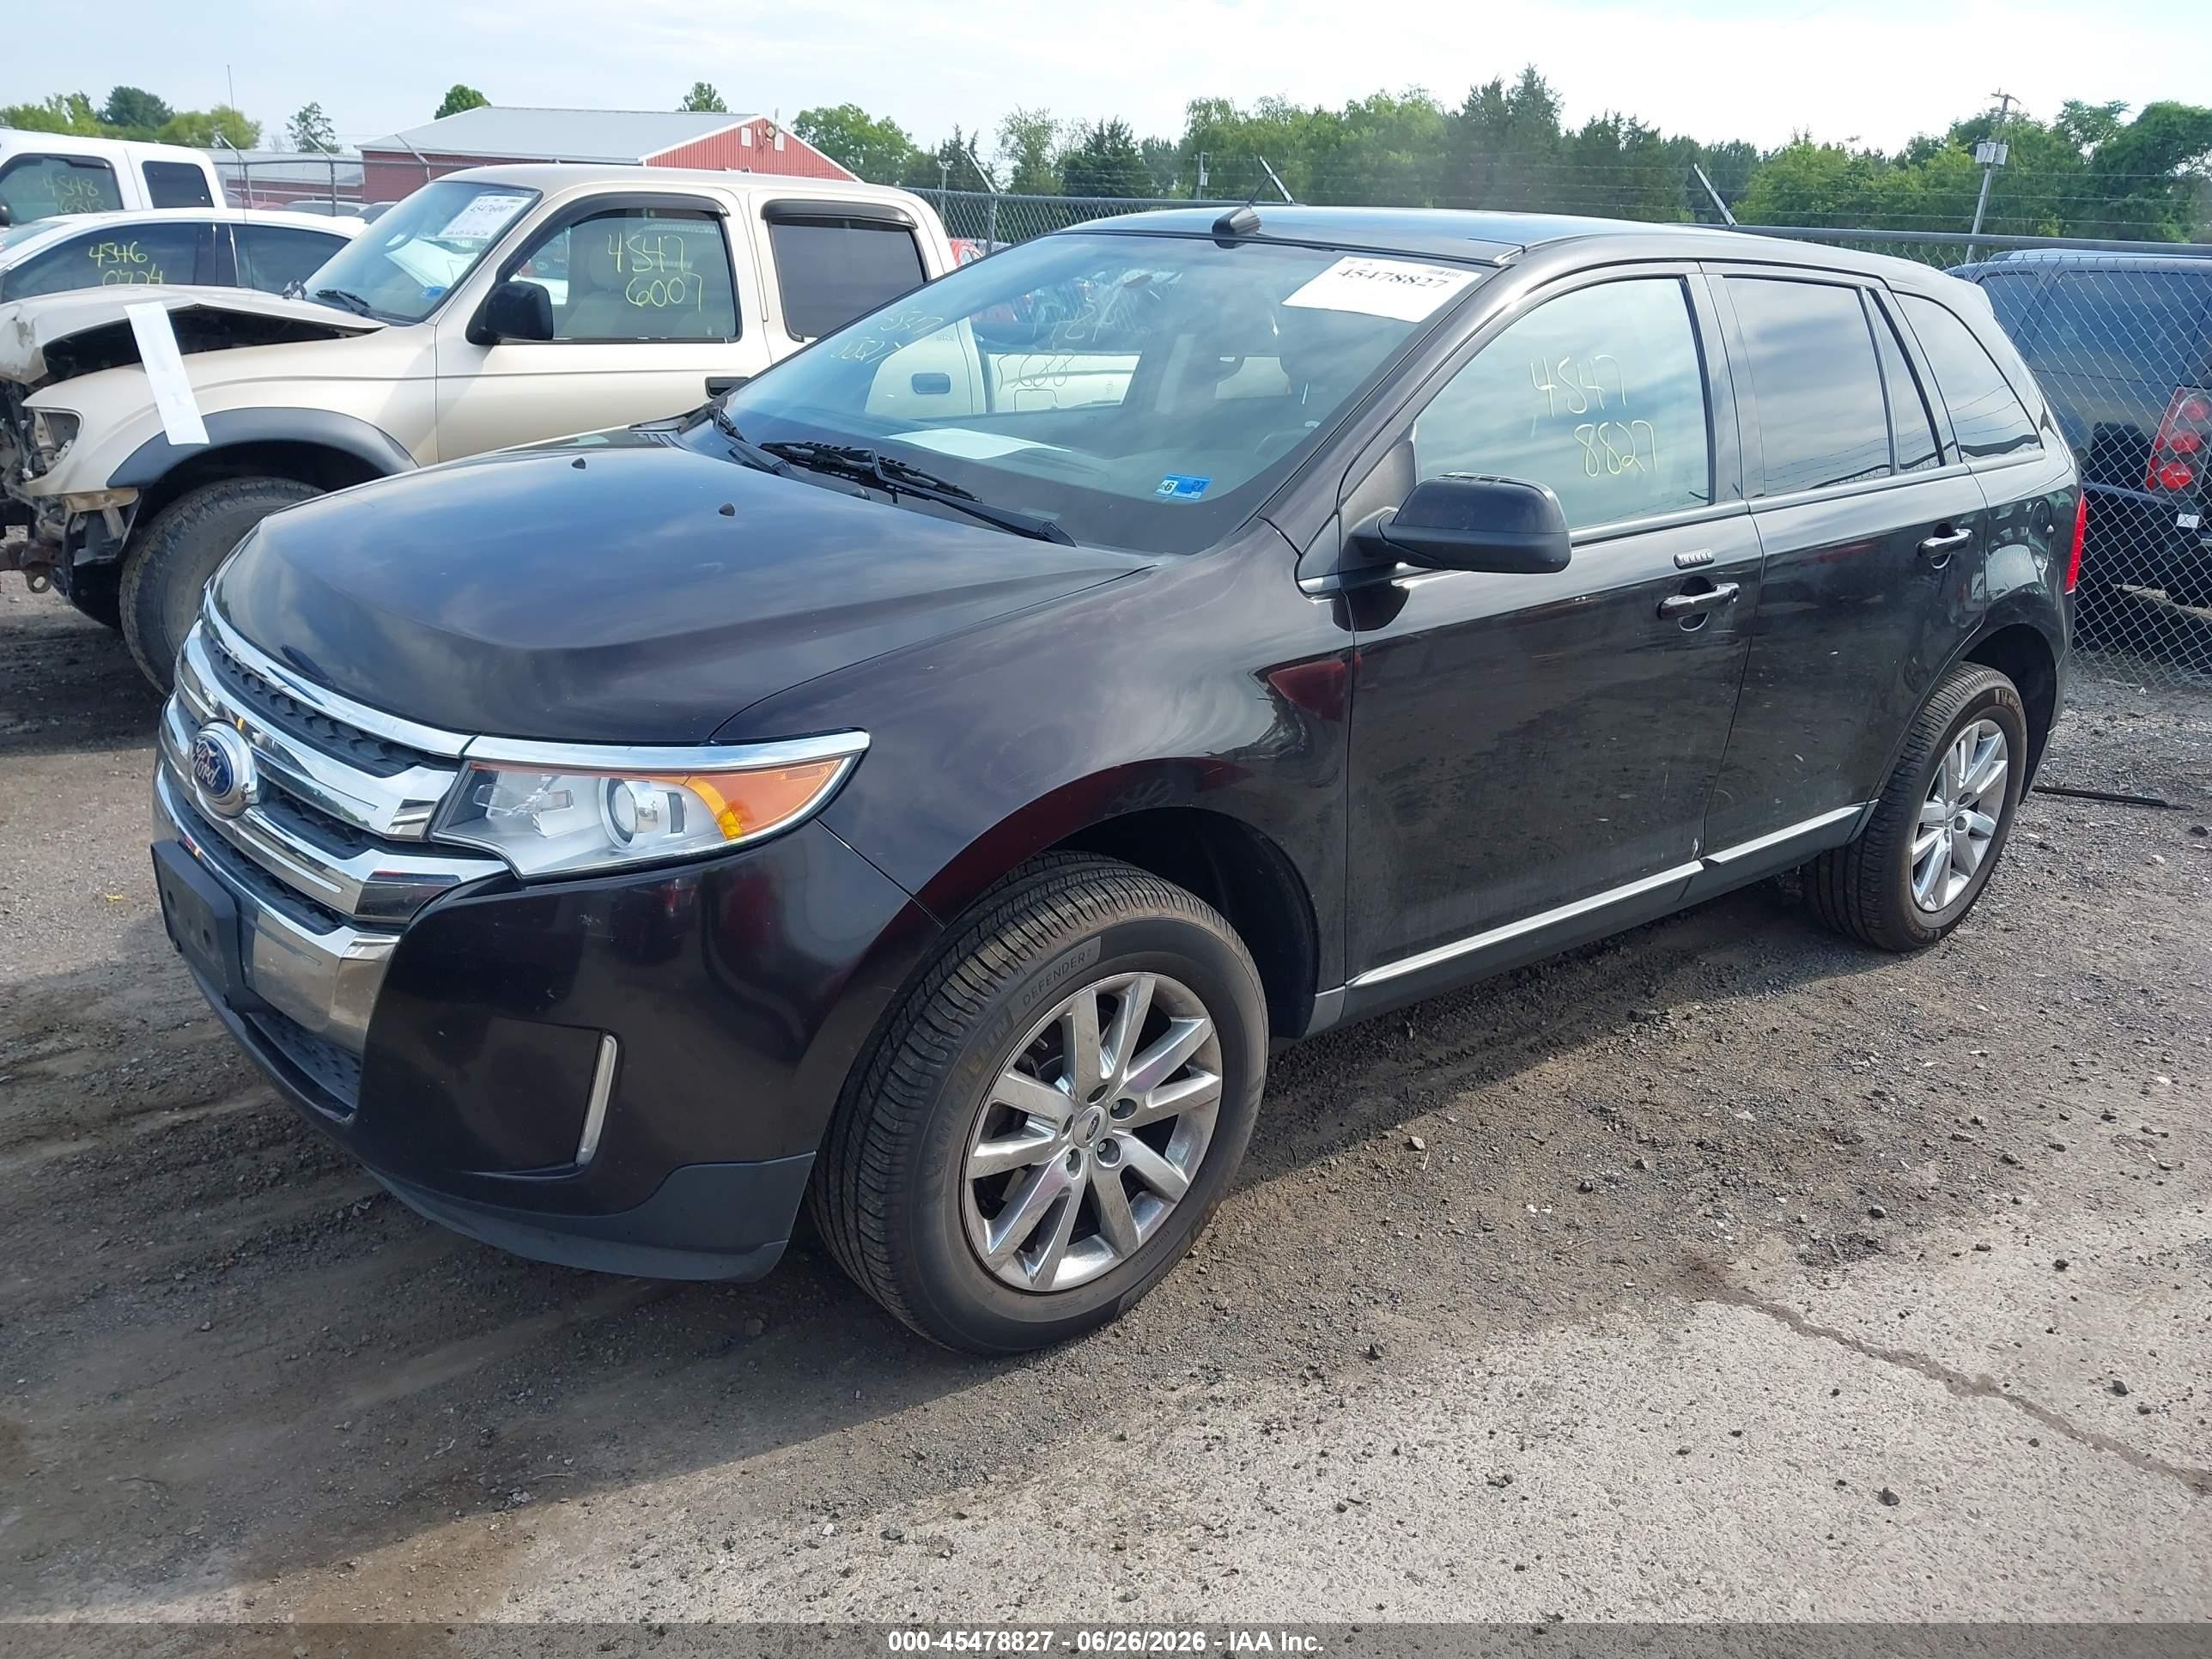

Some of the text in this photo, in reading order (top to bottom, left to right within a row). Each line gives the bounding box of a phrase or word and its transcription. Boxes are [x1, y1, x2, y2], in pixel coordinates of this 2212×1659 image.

[88, 241, 149, 268] 4546
[608, 232, 684, 273] 4547
[626, 271, 702, 313] 6007
[1337, 268, 1449, 289] 45478827
[1529, 355, 1626, 418] 4547
[1573, 420, 1658, 477] 8827
[193, 739, 222, 788] Ford
[1022, 952, 1086, 1006] DEFENDER
